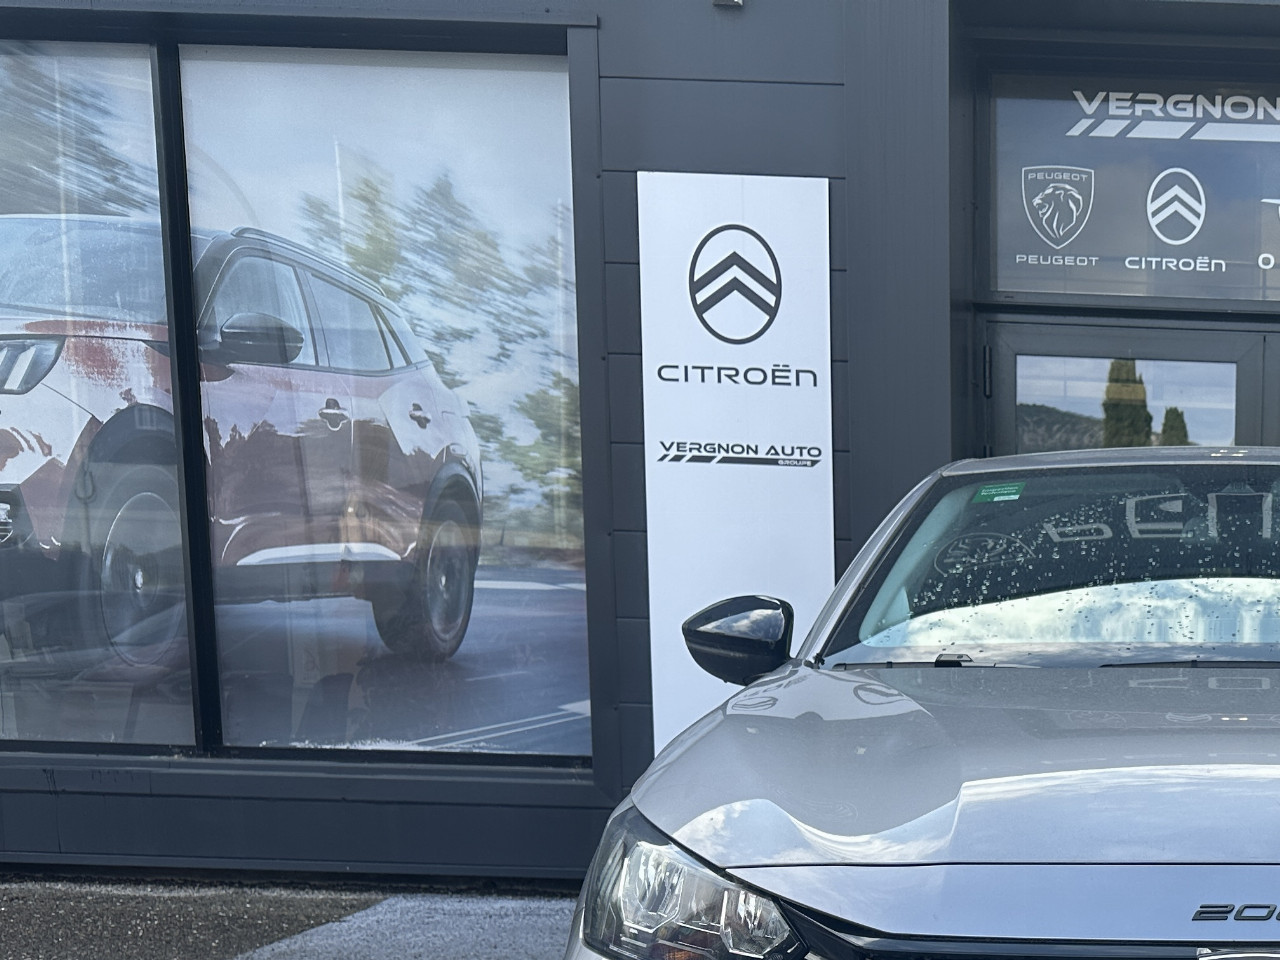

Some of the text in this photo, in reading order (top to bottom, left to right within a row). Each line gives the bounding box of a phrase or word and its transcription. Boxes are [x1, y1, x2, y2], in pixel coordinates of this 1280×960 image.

[1028, 172, 1088, 183] PEUGEOT
[1015, 254, 1099, 267] PEUGEOT
[659, 440, 822, 458] VERGNON AUTO
[778, 459, 812, 467] GROUPE
